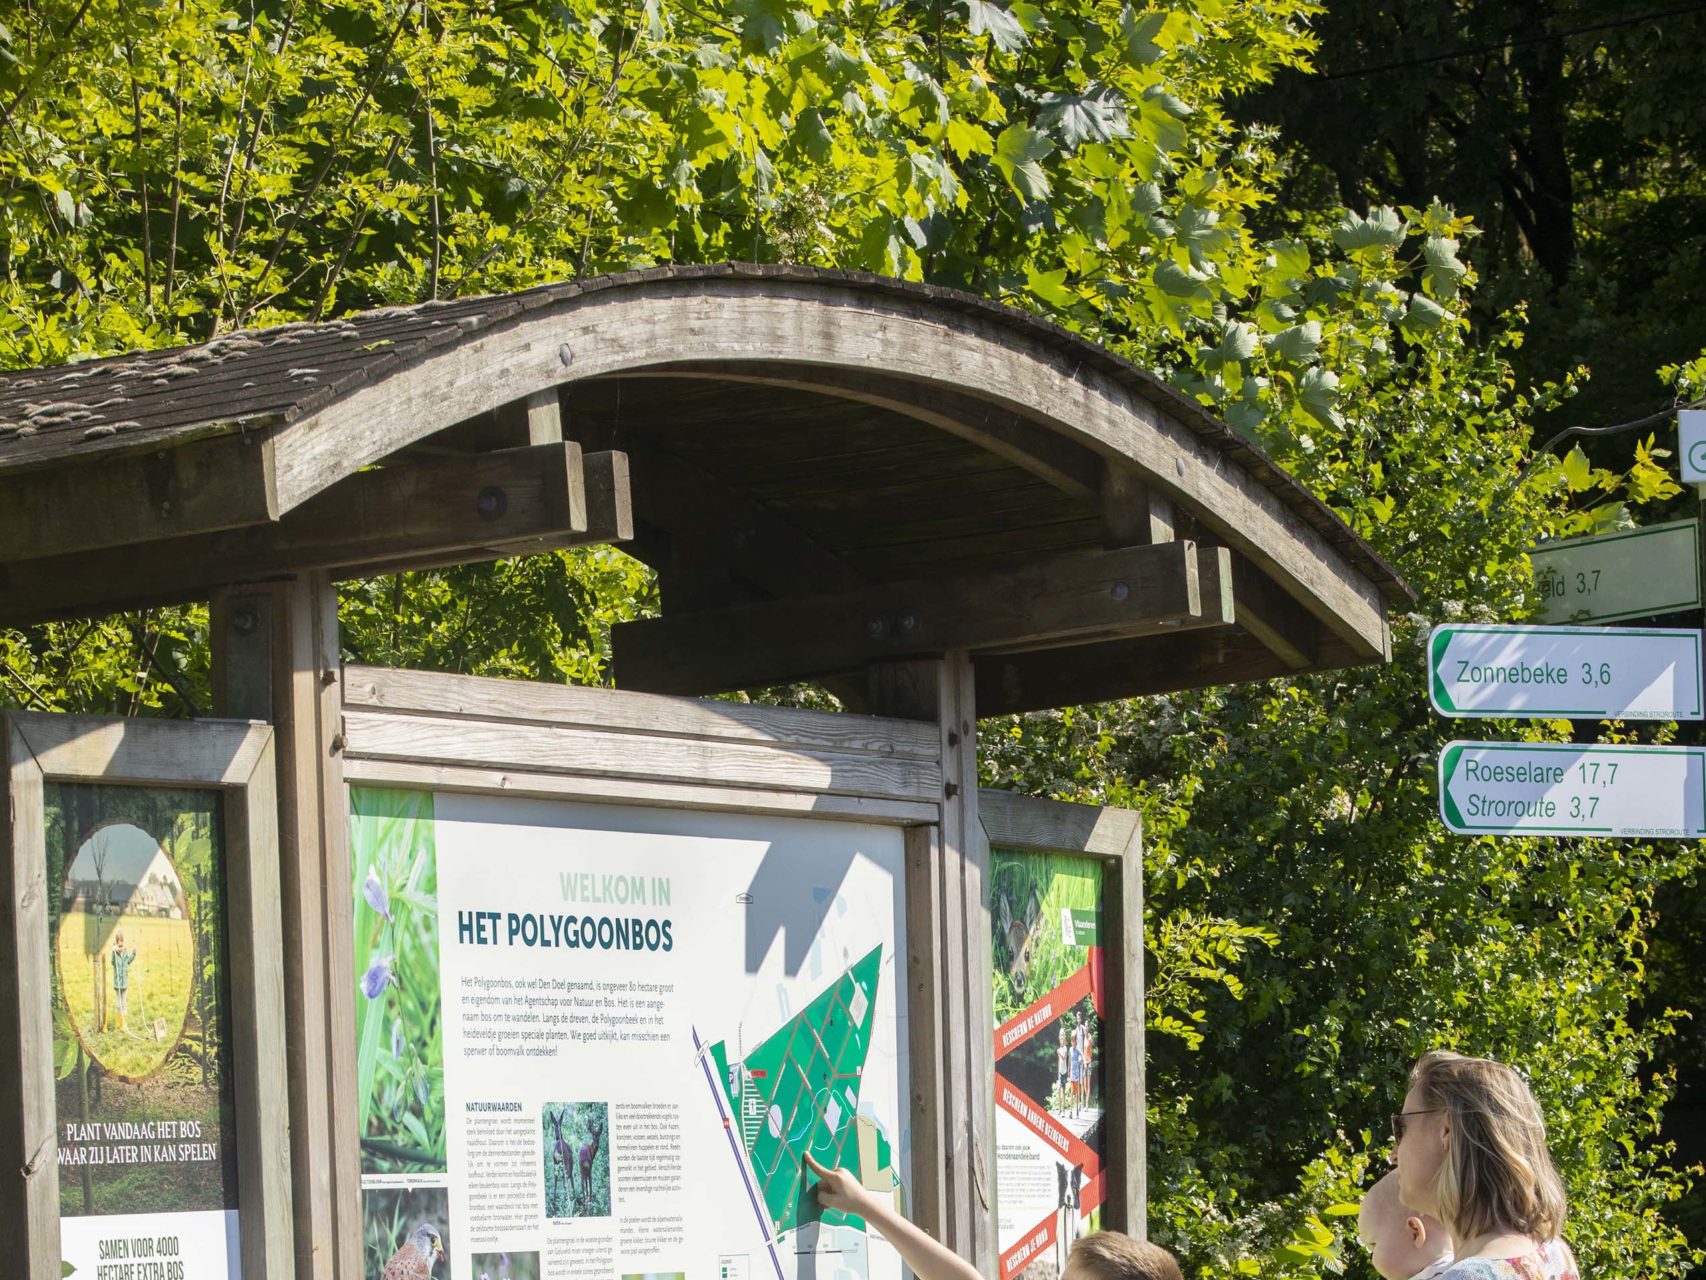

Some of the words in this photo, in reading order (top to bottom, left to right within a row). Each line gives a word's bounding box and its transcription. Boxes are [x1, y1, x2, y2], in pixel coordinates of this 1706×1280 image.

[1576, 569, 1601, 596] 3,7
[1456, 660, 1568, 685] Zonnebeke
[1581, 662, 1612, 688] 3,6
[1465, 759, 1564, 785] Roeselare
[1578, 762, 1619, 788] 17,7
[1467, 794, 1557, 818] Stroroute
[1570, 796, 1600, 820] 3,7
[560, 872, 645, 906] WELKOM
[652, 877, 672, 906] IN
[458, 911, 501, 945] HET
[507, 912, 673, 952] POLYGOONBOS
[461, 975, 472, 987] Het
[515, 977, 525, 989] ook
[527, 977, 537, 989] wel
[538, 977, 550, 990] Den
[552, 978, 565, 990] Doel
[595, 979, 600, 991] is
[602, 982, 627, 995] ongeveer
[637, 980, 657, 993] hectare
[659, 981, 673, 996] groot
[462, 996, 469, 1005] en
[470, 993, 500, 1008] eigendom
[502, 997, 512, 1006] van
[513, 994, 522, 1006] het
[524, 994, 558, 1010] Agentschap
[559, 998, 572, 1007] voor
[573, 995, 593, 1008] Natuur
[595, 999, 602, 1008] en
[617, 996, 628, 1009] Het
[629, 997, 634, 1009] is
[635, 1000, 645, 1009] een
[465, 1102, 522, 1112] NATUURWAARDEN
[67, 1123, 101, 1141] PLANT
[104, 1121, 155, 1140] VANDAAG
[157, 1121, 178, 1139] HET
[180, 1120, 201, 1138] BOS
[57, 1147, 87, 1165] WAAR
[89, 1146, 104, 1164] ZIJ
[106, 1145, 139, 1163] LATER
[140, 1145, 152, 1162] IN
[154, 1144, 176, 1162] KAN
[178, 1143, 217, 1161] SPELEN
[99, 1239, 129, 1260] SAMEN
[130, 1238, 154, 1258] VOOR
[157, 1236, 179, 1257] 4000
[167, 1260, 184, 1280] BOS
